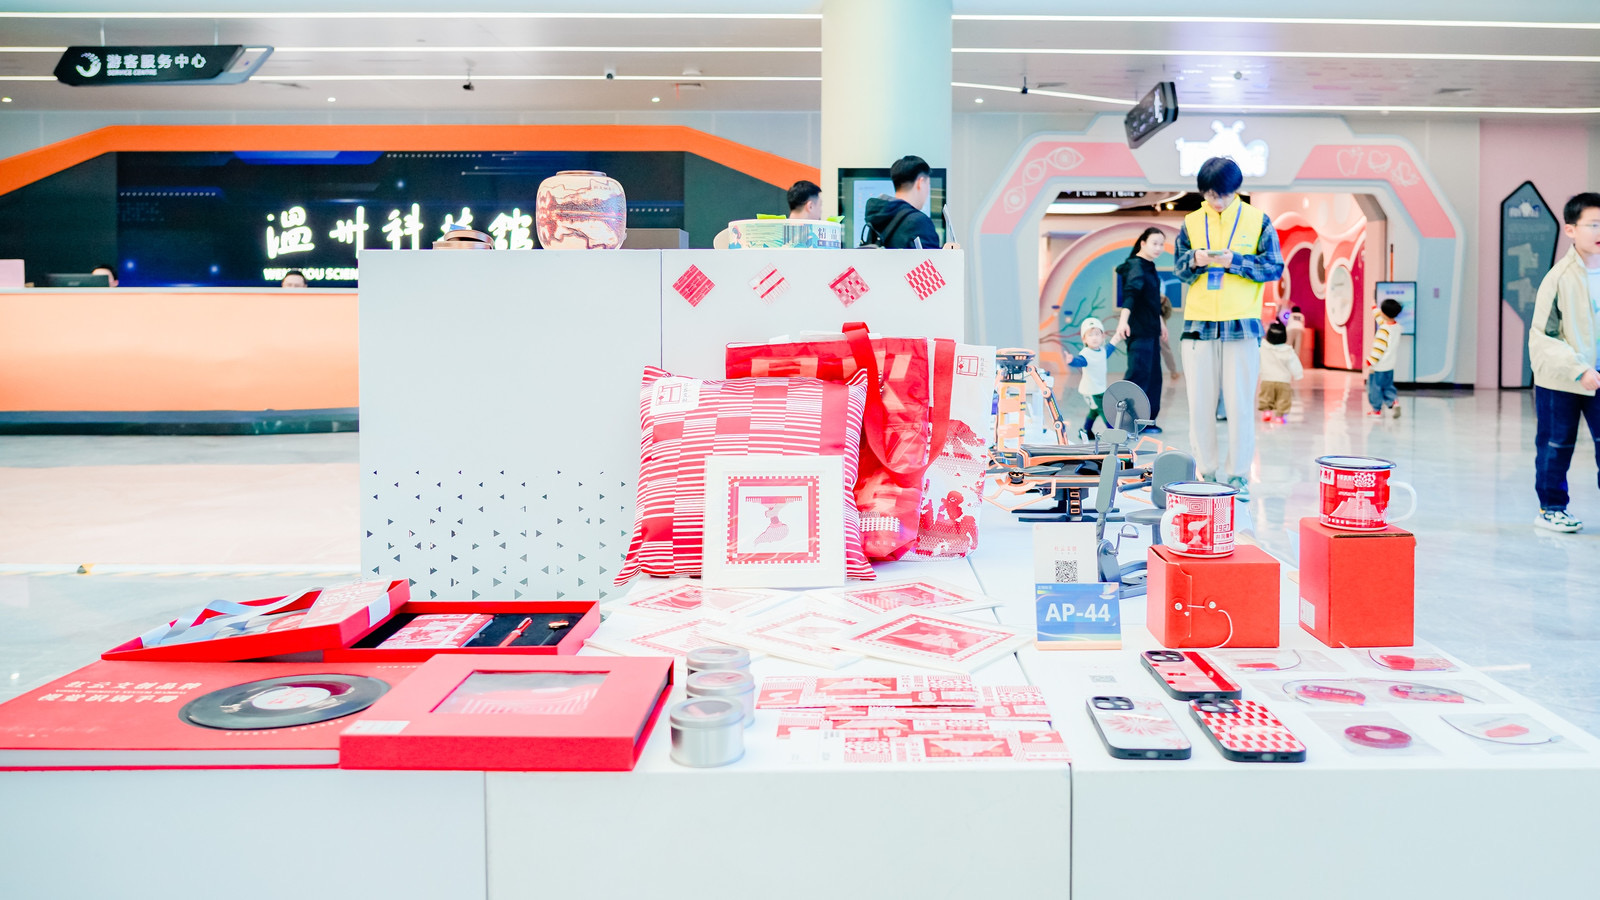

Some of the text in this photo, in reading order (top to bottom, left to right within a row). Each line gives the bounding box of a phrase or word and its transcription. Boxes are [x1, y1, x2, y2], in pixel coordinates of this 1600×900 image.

[106, 53, 207, 69] 游客服务中心
[1045, 603, 1111, 622] AP-44
